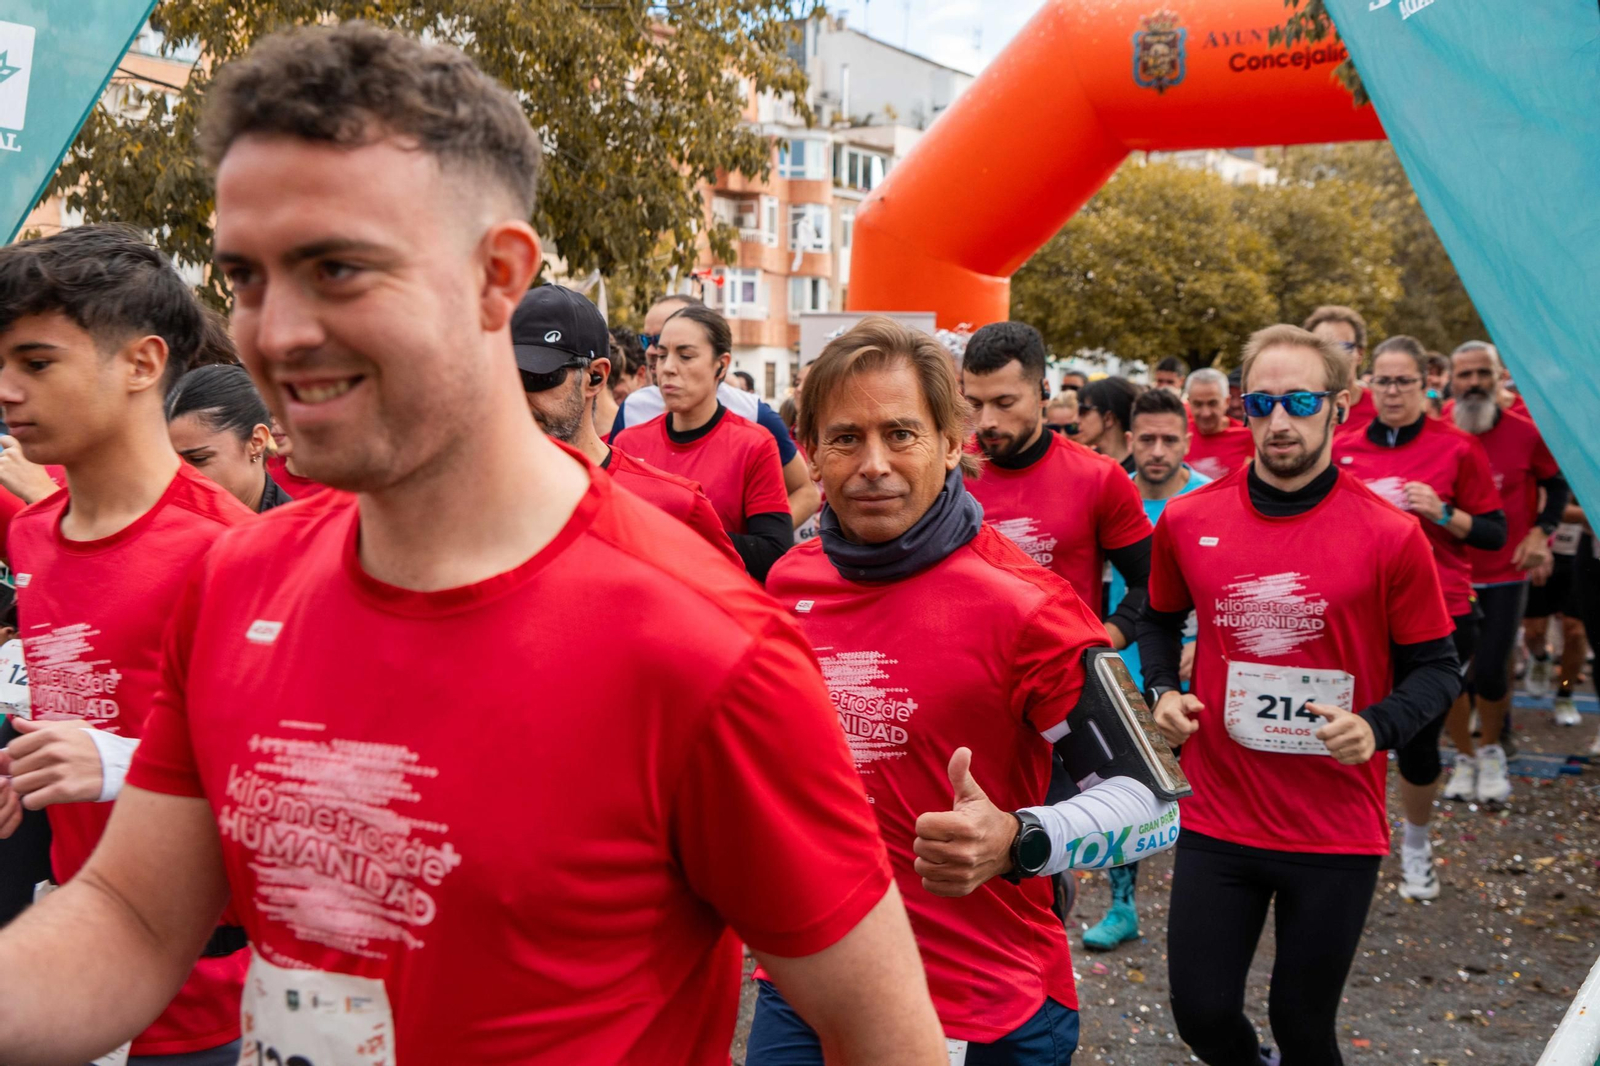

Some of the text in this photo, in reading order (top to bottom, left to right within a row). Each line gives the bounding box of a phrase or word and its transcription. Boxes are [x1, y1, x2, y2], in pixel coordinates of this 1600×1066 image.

[1215, 614, 1325, 630] HUMANIDAD
[881, 697, 911, 722] de
[1256, 694, 1321, 723] 214
[837, 711, 909, 745] NIDAD
[1263, 725, 1312, 737] CARLOS
[1135, 825, 1179, 852] SALO
[1138, 819, 1160, 835] GRAN
[1066, 825, 1133, 868] 10K
[219, 805, 436, 926] HUMANIDAD
